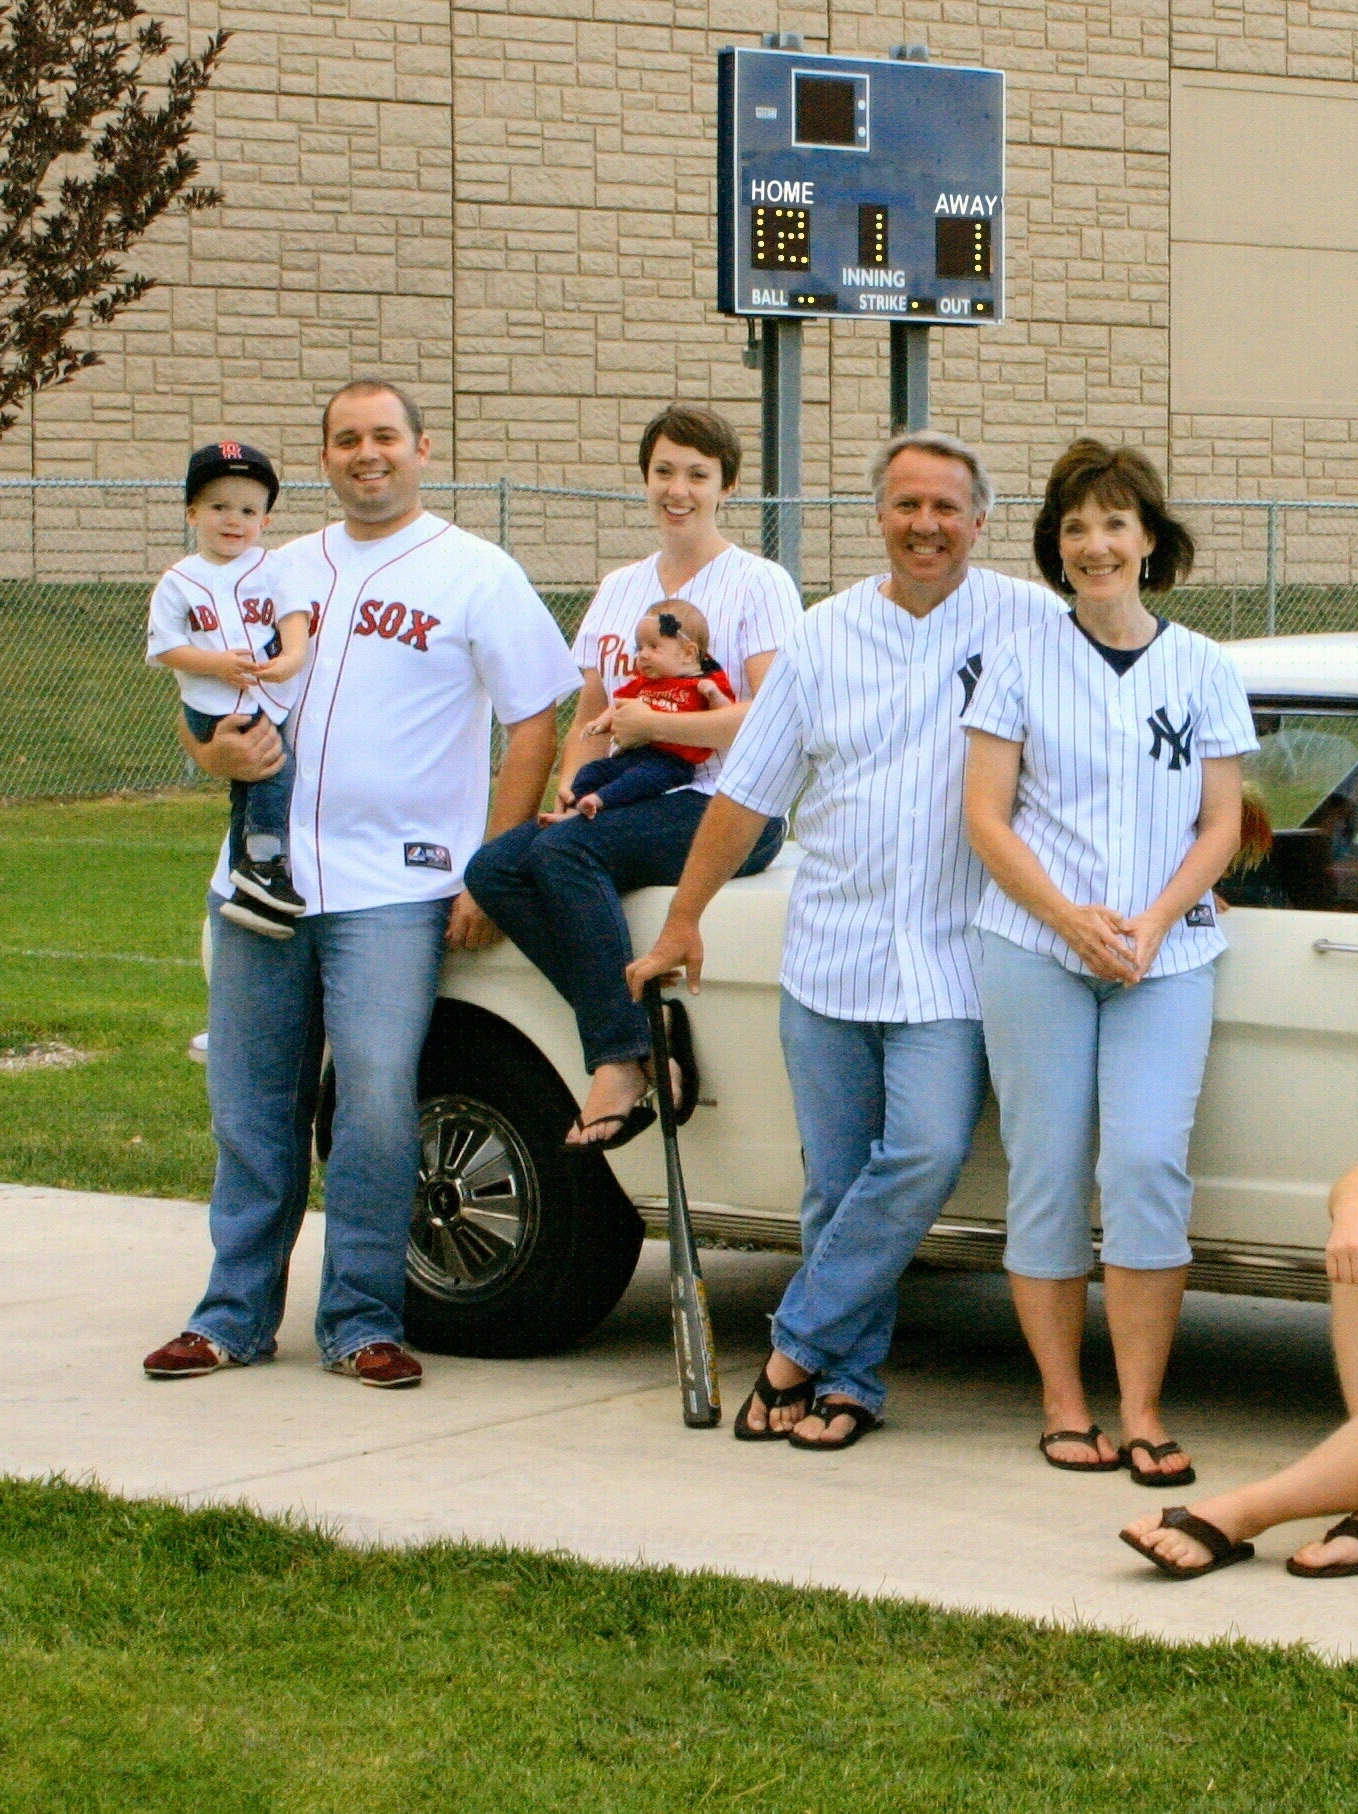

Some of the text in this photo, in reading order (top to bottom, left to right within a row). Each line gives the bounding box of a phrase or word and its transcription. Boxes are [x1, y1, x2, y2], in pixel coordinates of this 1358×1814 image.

[751, 178, 815, 204] HOME
[934, 192, 998, 216] AWAY
[842, 268, 906, 288] INNING
[752, 288, 789, 306] BALL
[859, 294, 908, 312] STRIKE
[940, 298, 971, 315] OUT
[242, 598, 275, 626] SO
[353, 600, 441, 652] SOX
[1147, 706, 1191, 771] NY
